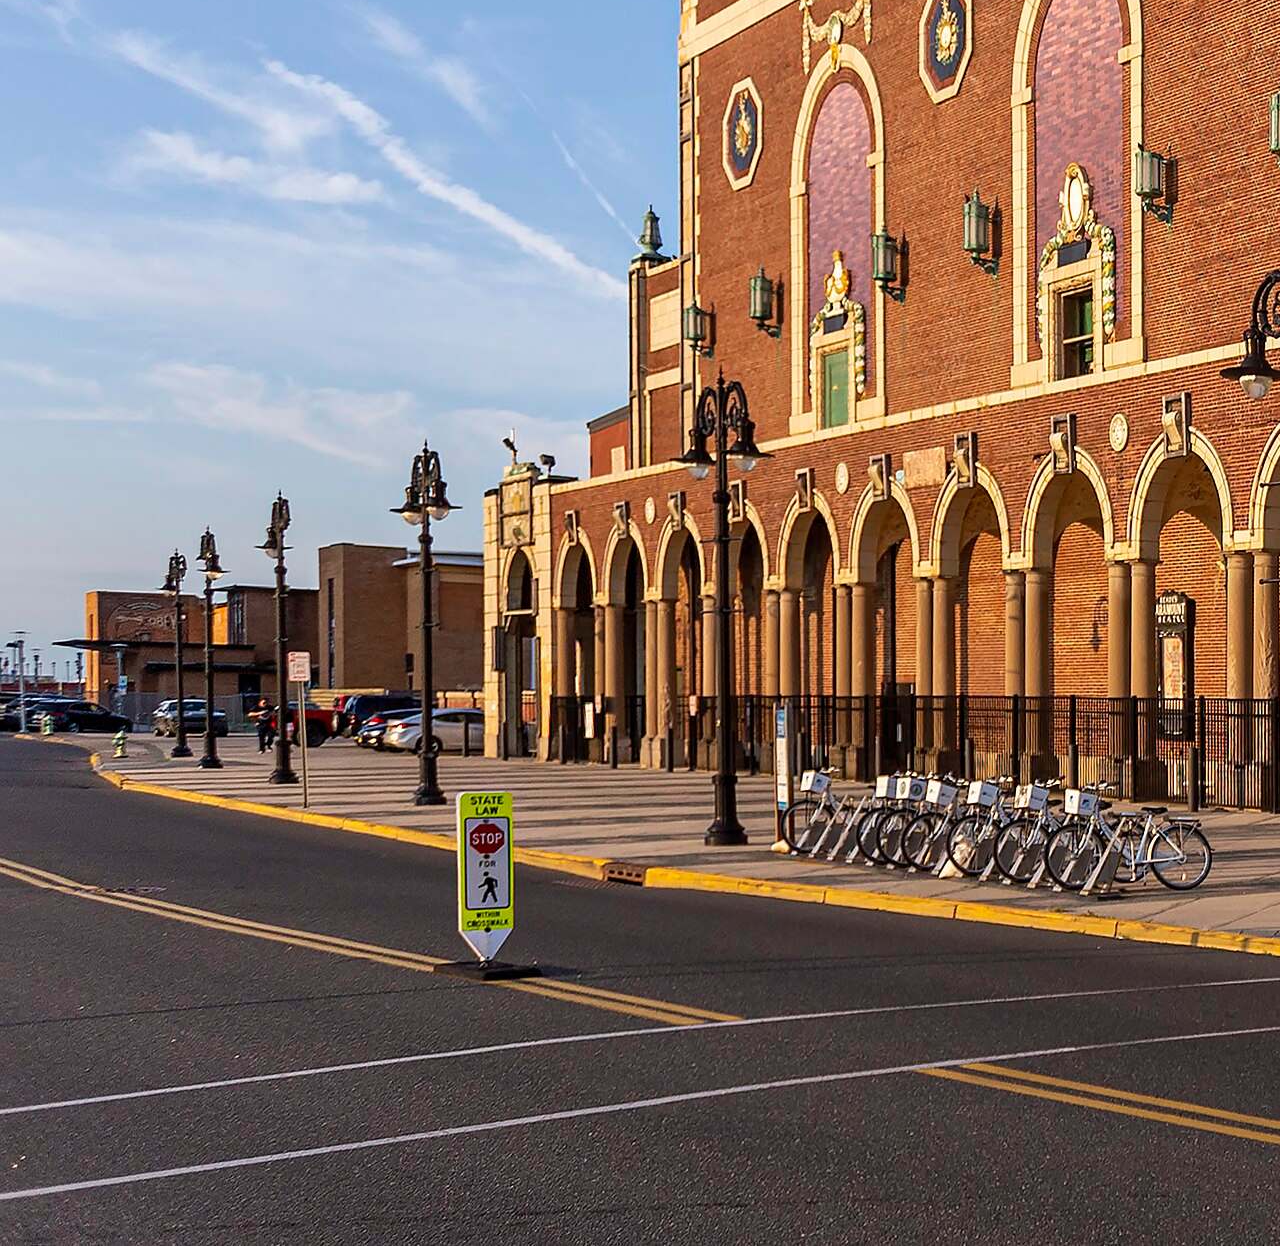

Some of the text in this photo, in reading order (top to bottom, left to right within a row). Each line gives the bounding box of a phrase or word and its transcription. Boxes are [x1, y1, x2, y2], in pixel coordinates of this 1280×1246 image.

[470, 795, 504, 806] STATE
[475, 805, 499, 816] LAW
[471, 832, 503, 846] STOP
[478, 859, 497, 868] FOR
[466, 918, 509, 928] CROSSWALK
